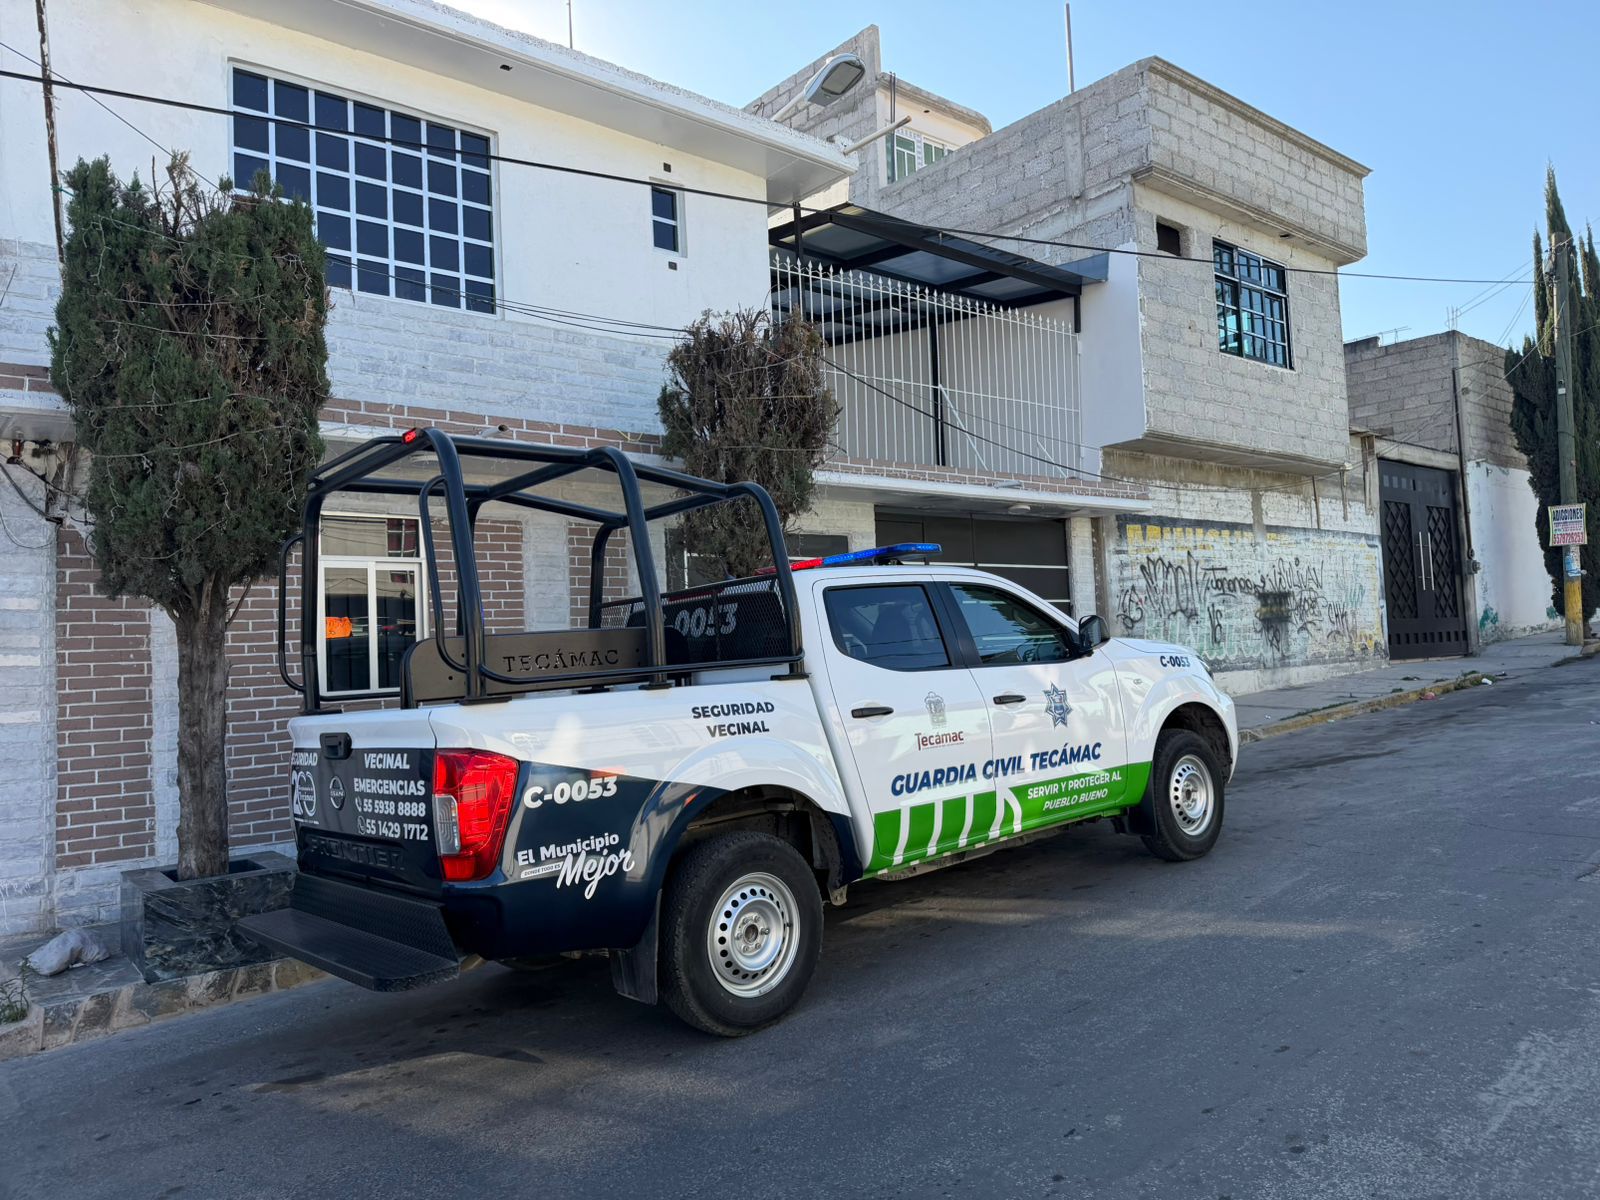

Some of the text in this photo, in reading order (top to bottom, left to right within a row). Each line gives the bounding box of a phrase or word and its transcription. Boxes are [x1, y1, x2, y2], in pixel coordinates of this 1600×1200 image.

[1552, 508, 1582, 521] ADICCIONES
[503, 648, 619, 672] TECÁMAC
[1160, 655, 1191, 667] C-0053
[691, 702, 775, 719] SEGURIDAD
[706, 720, 769, 738] VECINAL
[914, 731, 964, 751] Tecámac
[364, 753, 410, 769] VECINAL
[891, 742, 1102, 796] GUARDIA CIVIL TECÁMAC
[353, 778, 426, 796] EMERGENCIAS
[523, 776, 618, 809] C-0053
[1027, 769, 1122, 800] SERVIR Y PROTEGER AL
[363, 798, 426, 817] 55 5938 8888
[1042, 788, 1109, 811] PUEBLO BUENO
[366, 818, 428, 841] 55 1429 1712
[517, 832, 620, 866] El Municipio
[556, 848, 635, 900] Mejor
